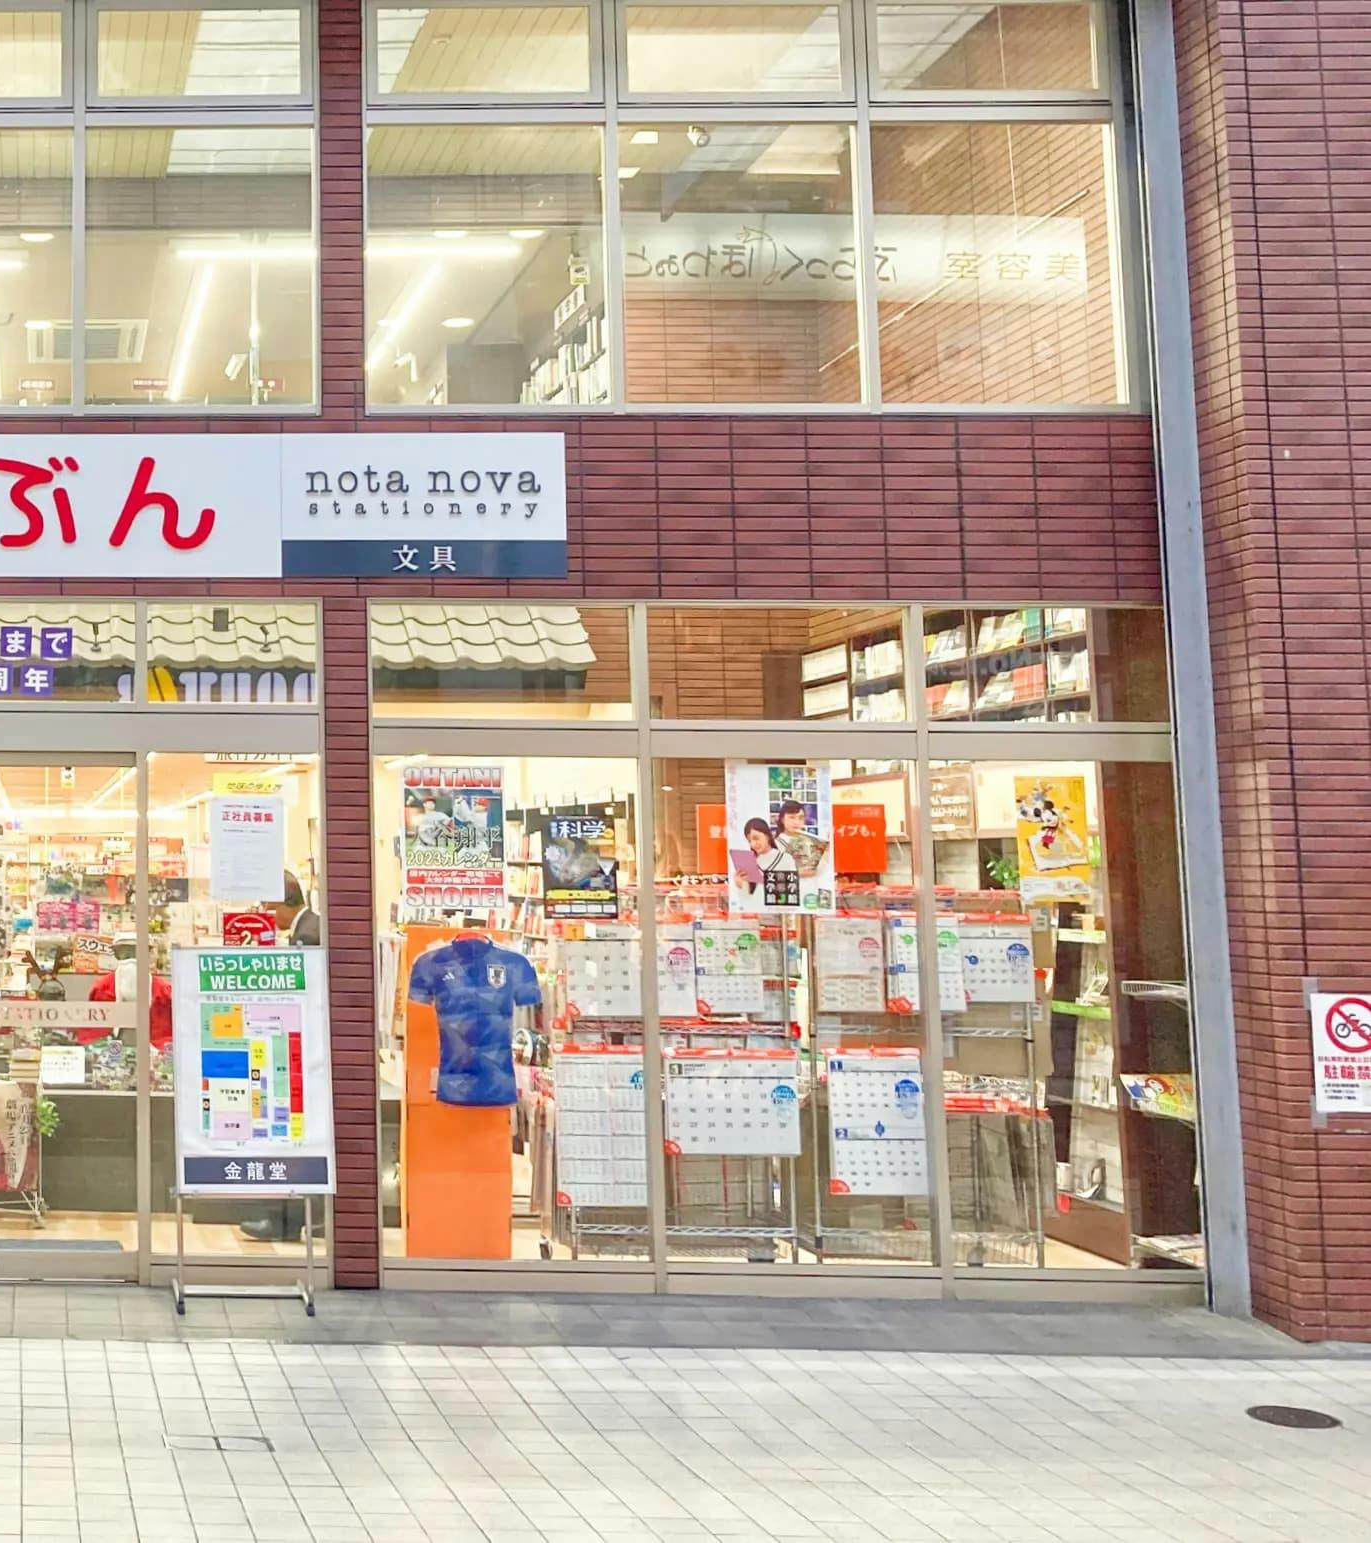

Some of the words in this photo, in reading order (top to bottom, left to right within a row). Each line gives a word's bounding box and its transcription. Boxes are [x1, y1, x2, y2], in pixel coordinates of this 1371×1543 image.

[306, 464, 409, 495] nota
[427, 465, 542, 495] nova
[308, 501, 540, 519] stationery
[392, 544, 457, 572] 文具
[403, 767, 502, 788] OHTANI
[558, 820, 605, 838] 科学
[405, 887, 505, 907] SHOHEI
[199, 956, 302, 972] いらっしゃいませ
[210, 974, 297, 990] WELCOME
[223, 1161, 288, 1182] 金龍堂
